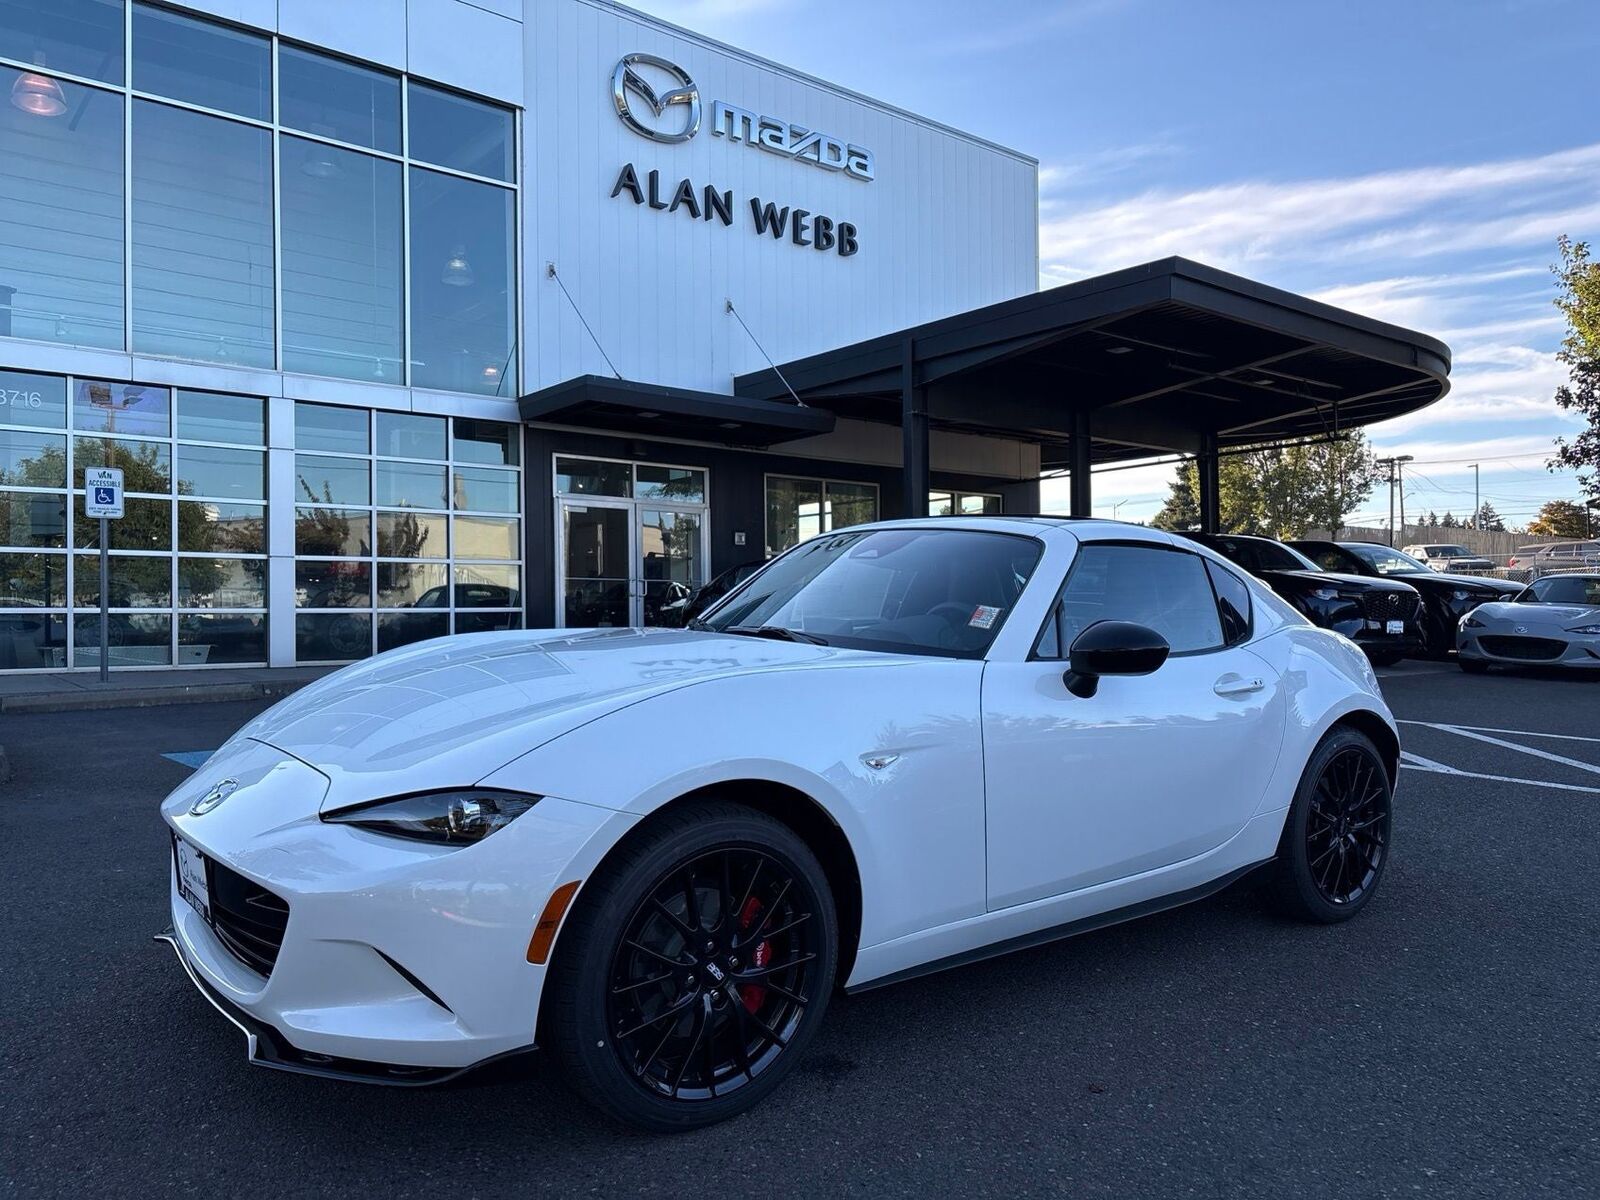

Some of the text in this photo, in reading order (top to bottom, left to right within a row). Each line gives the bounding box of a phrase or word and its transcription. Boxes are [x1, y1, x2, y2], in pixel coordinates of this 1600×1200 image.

[610, 162, 859, 257] ALAN WEBB
[97, 471, 112, 479] VAN
[88, 479, 121, 488] ACCESSIBLE
[706, 962, 725, 981] BBS
